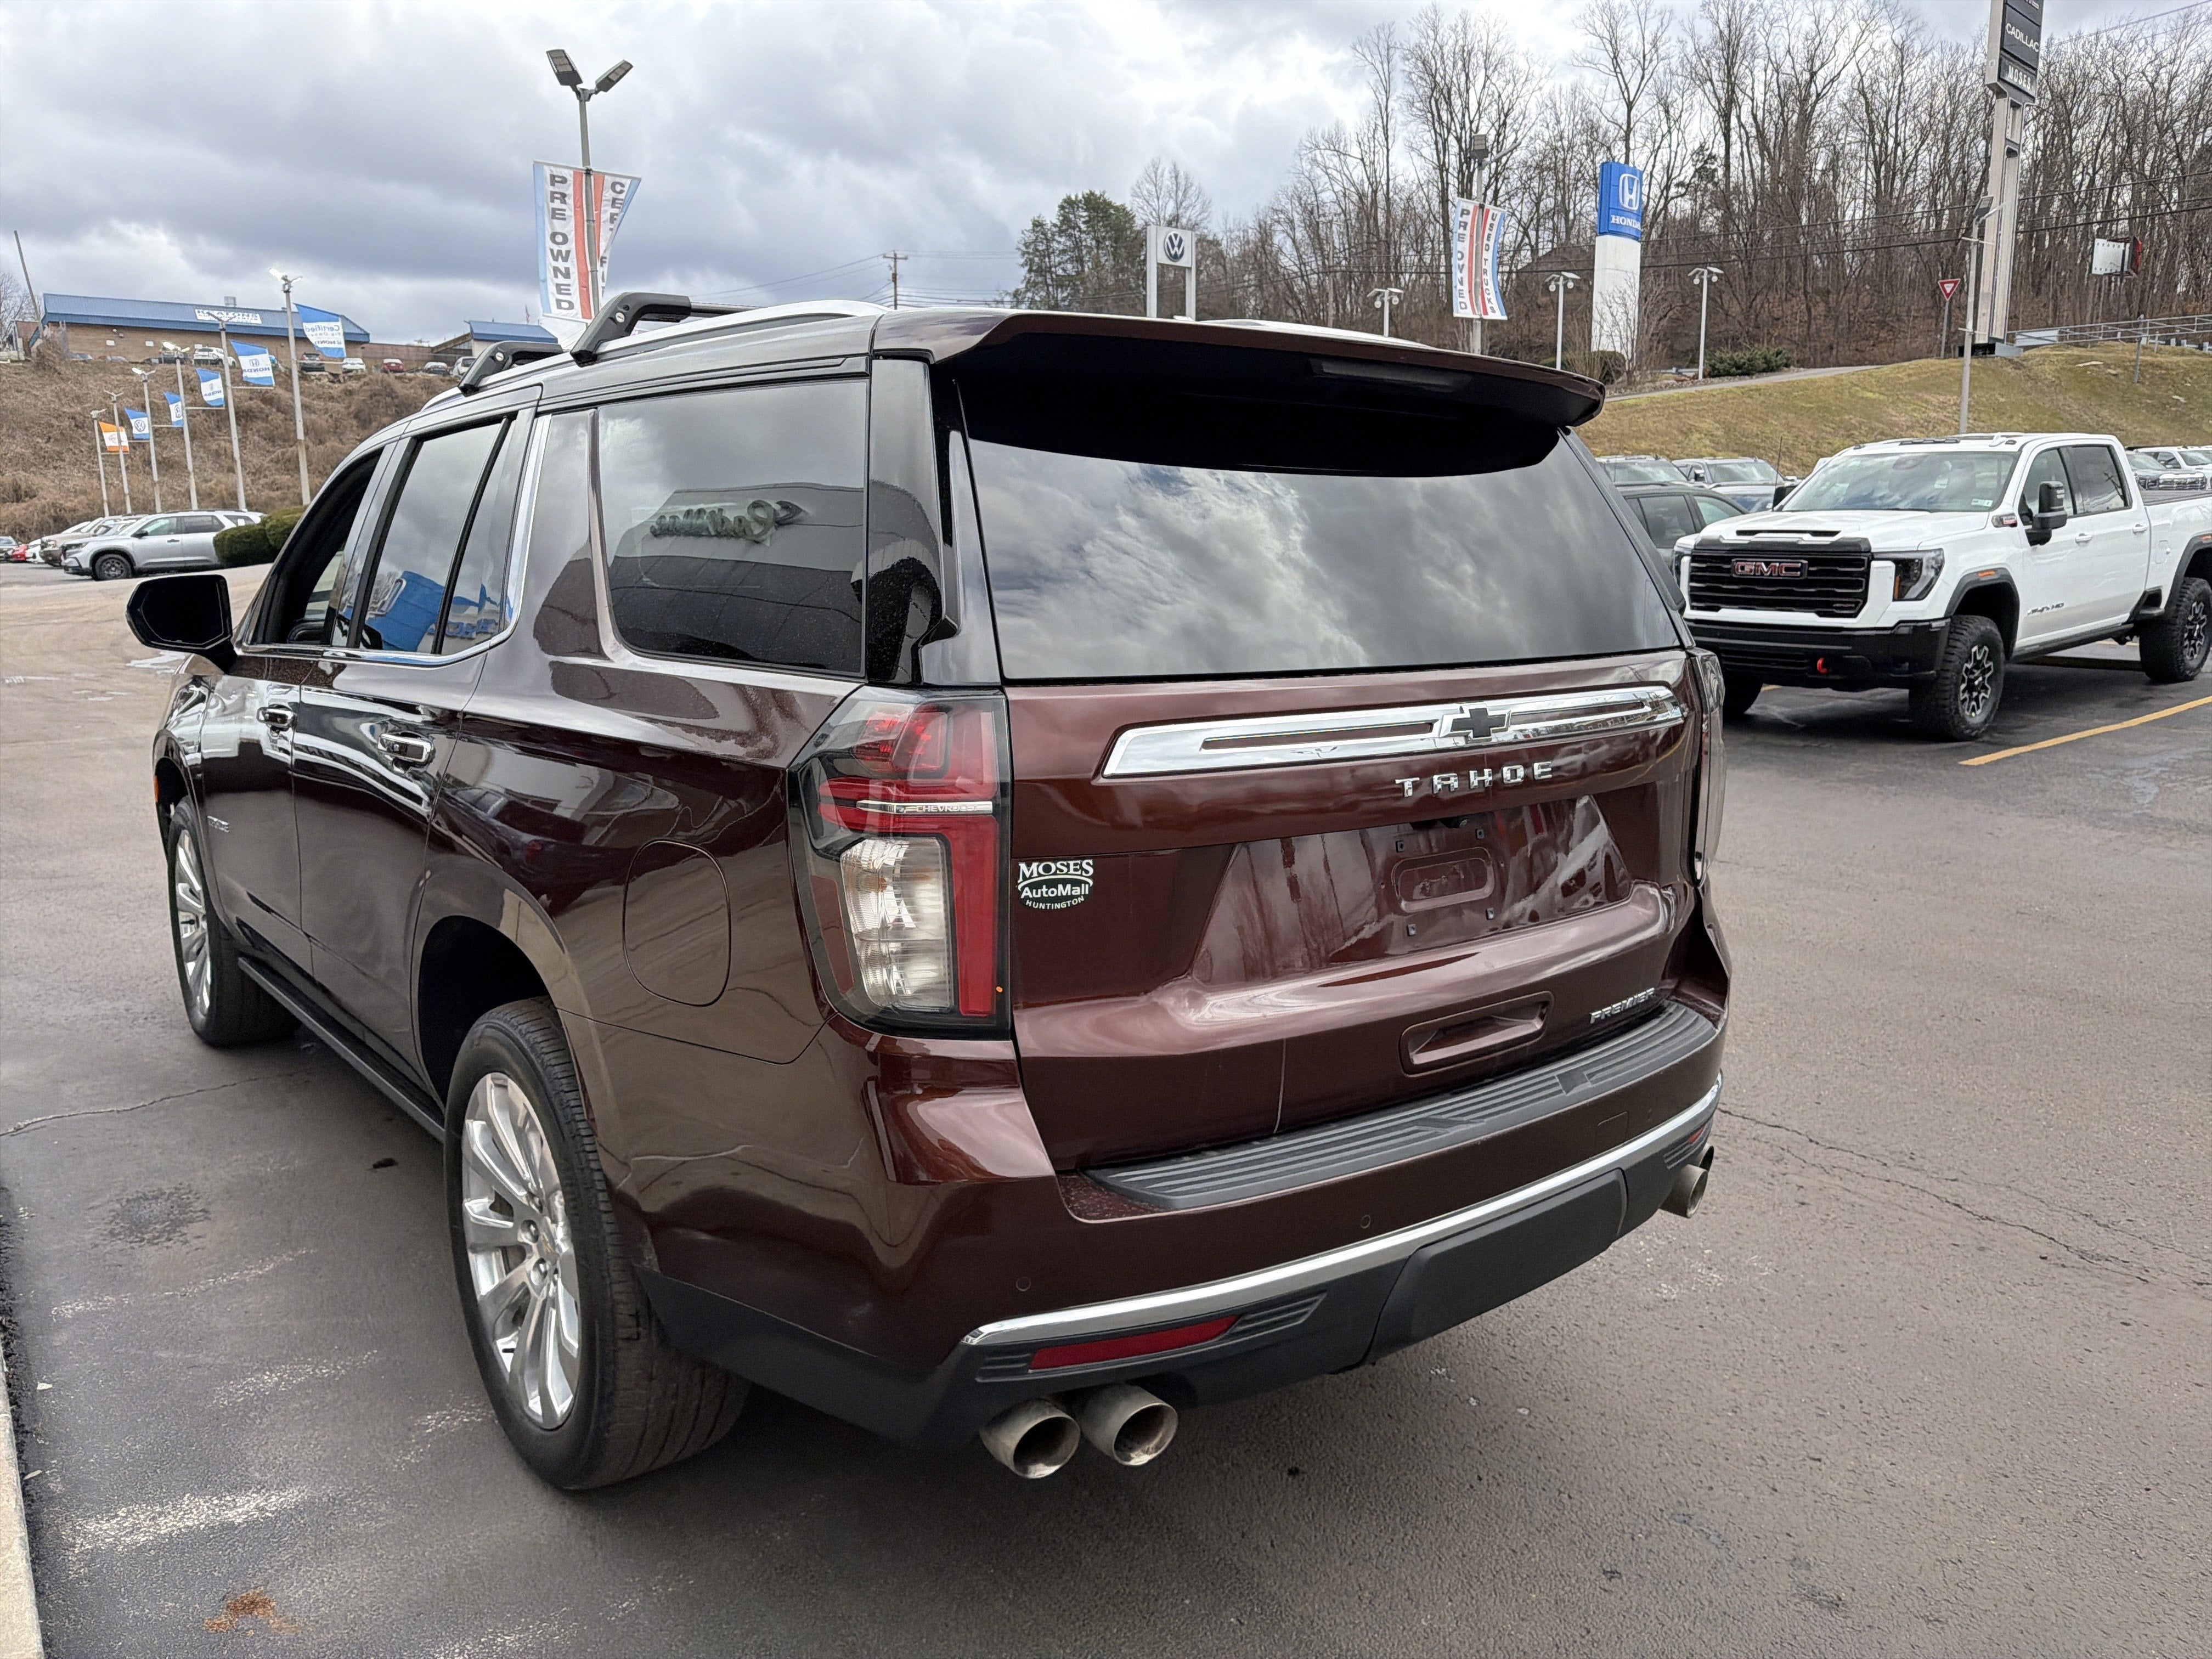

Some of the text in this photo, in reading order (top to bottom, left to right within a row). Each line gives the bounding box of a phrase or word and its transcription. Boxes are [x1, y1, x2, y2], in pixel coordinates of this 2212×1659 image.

[2006, 22, 2039, 53] CADILLAC
[2007, 65, 2031, 90] MOSES
[1458, 208, 1471, 242] PRE
[549, 173, 575, 311] PRE OWNED
[1483, 212, 1498, 314] USED TRUCKS
[1735, 562, 1802, 576] GMC
[1395, 761, 1552, 798] TAHOE
[1018, 859, 1094, 883] MOSES
[1020, 884, 1089, 899] AutoMall
[1026, 895, 1085, 910] HUNTINGTON
[1590, 988, 1656, 1024] PREMIER
